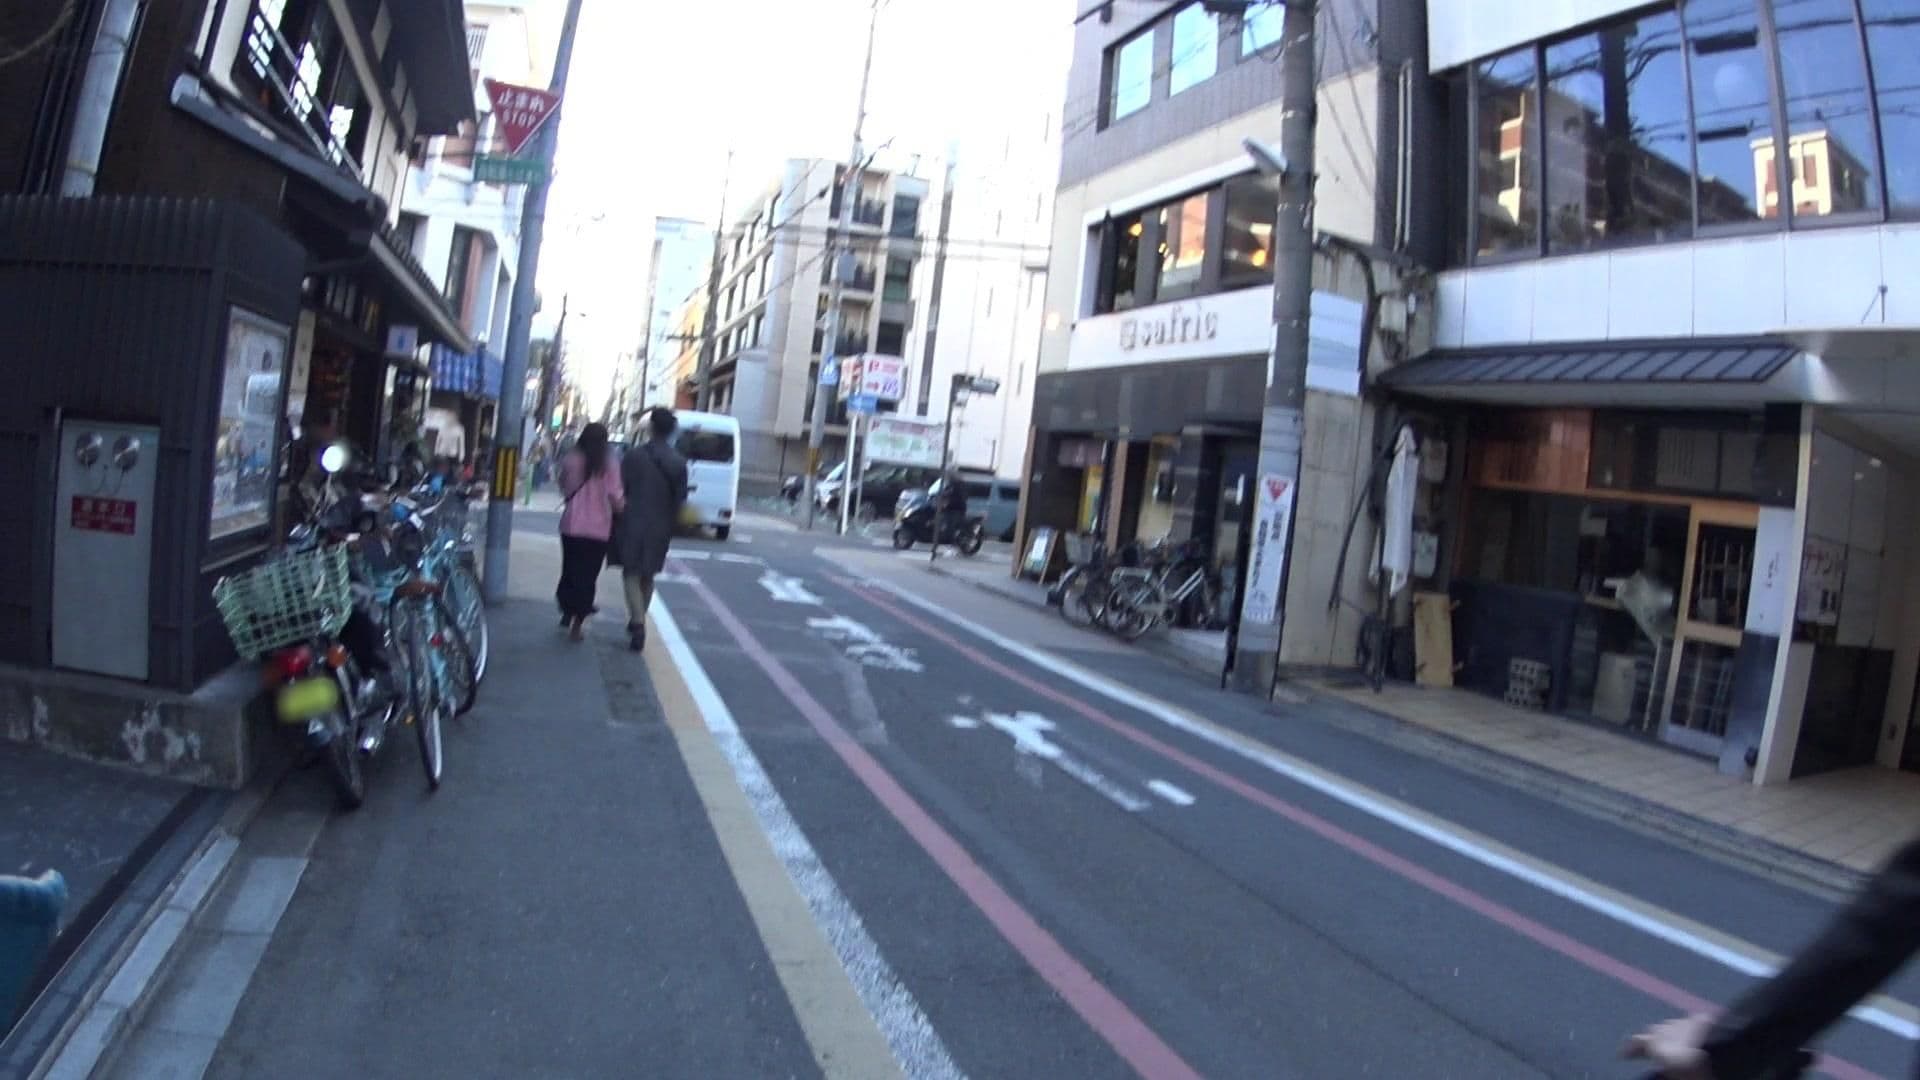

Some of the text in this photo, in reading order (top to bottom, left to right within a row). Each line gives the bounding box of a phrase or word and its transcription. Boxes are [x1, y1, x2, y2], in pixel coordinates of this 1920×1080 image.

[497, 87, 545, 113] 止まれ
[502, 108, 537, 128] STOP
